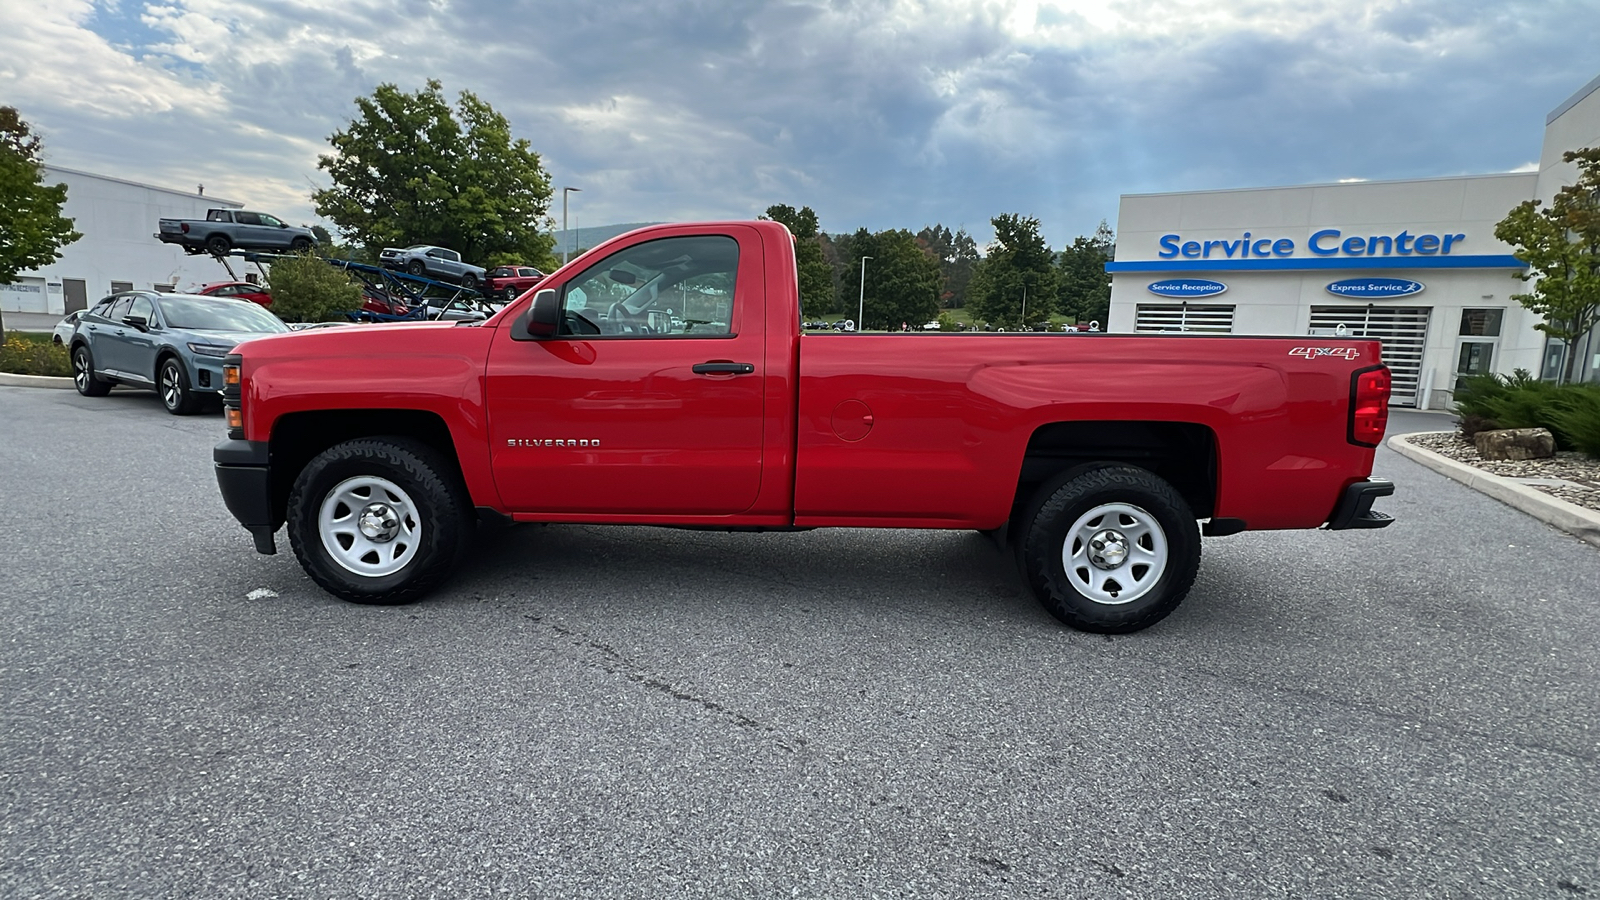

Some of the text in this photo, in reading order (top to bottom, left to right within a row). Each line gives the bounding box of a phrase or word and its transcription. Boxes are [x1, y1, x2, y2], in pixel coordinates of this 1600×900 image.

[1158, 229, 1466, 259] Service Center
[1331, 284, 1366, 292] Express
[507, 439, 600, 447] SILVERADO
